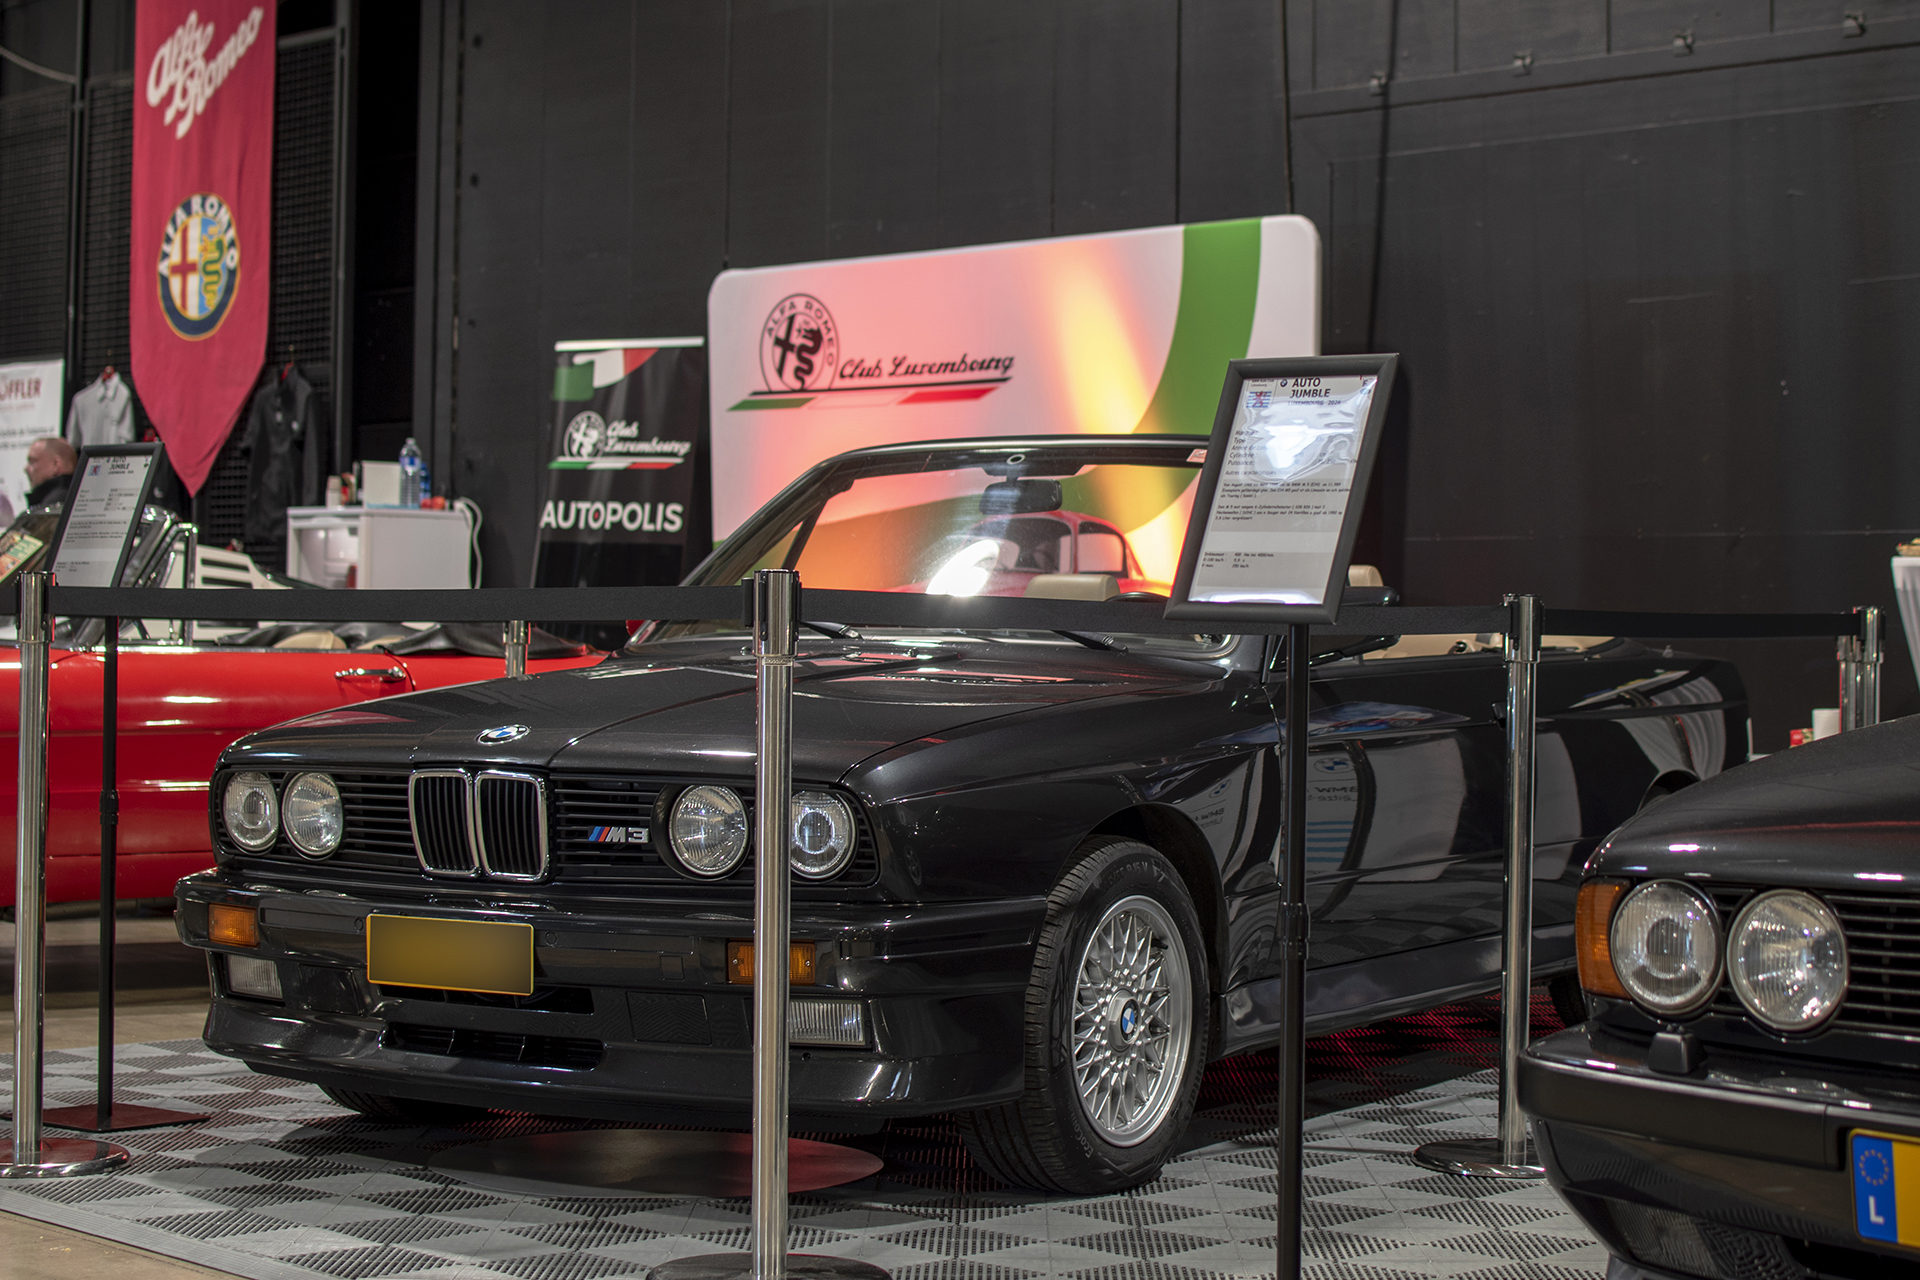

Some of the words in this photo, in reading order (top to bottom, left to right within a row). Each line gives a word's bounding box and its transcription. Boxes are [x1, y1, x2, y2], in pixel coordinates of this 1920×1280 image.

[145, 8, 215, 110] Alfa
[176, 5, 265, 141] Romeo
[158, 205, 187, 277] ALFA
[191, 194, 238, 270] ROMEO
[767, 301, 796, 339] ALFA
[804, 300, 835, 367] ROMEO
[839, 358, 882, 380] Club
[888, 353, 1015, 377] Luxembourg
[1290, 388, 1331, 398] JUMBLE
[1292, 378, 1321, 388] AUTO
[606, 419, 640, 439] Club
[603, 436, 692, 457] Luxembourg
[539, 500, 684, 533] AUTOPOLIS
[604, 826, 649, 843] M3
[1868, 1195, 1885, 1225] L
